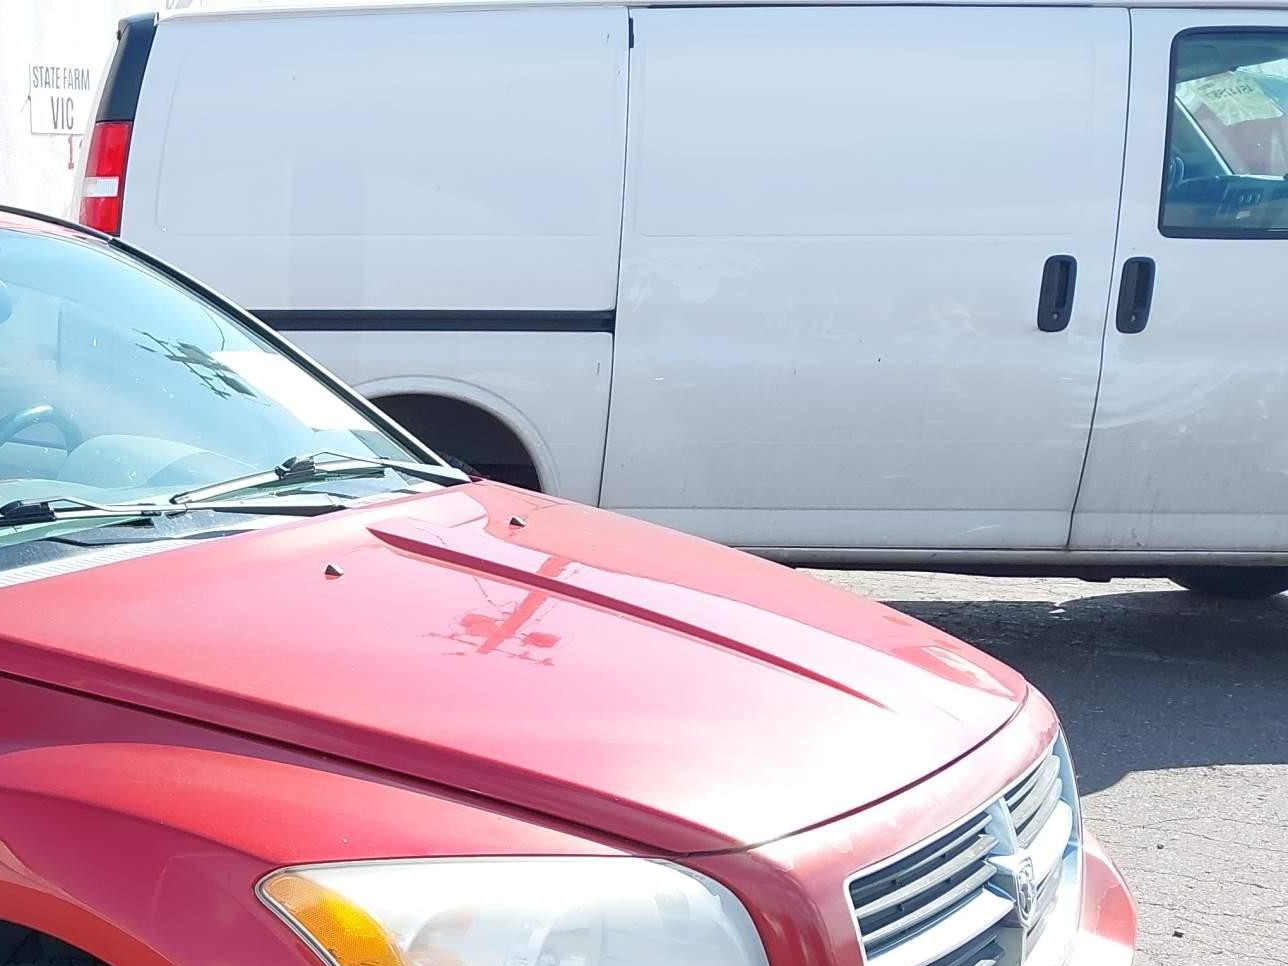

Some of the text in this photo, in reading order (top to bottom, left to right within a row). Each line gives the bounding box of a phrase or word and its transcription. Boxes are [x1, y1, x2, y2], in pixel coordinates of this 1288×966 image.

[32, 65, 91, 91] STATE FARM
[51, 96, 74, 130] VIC
